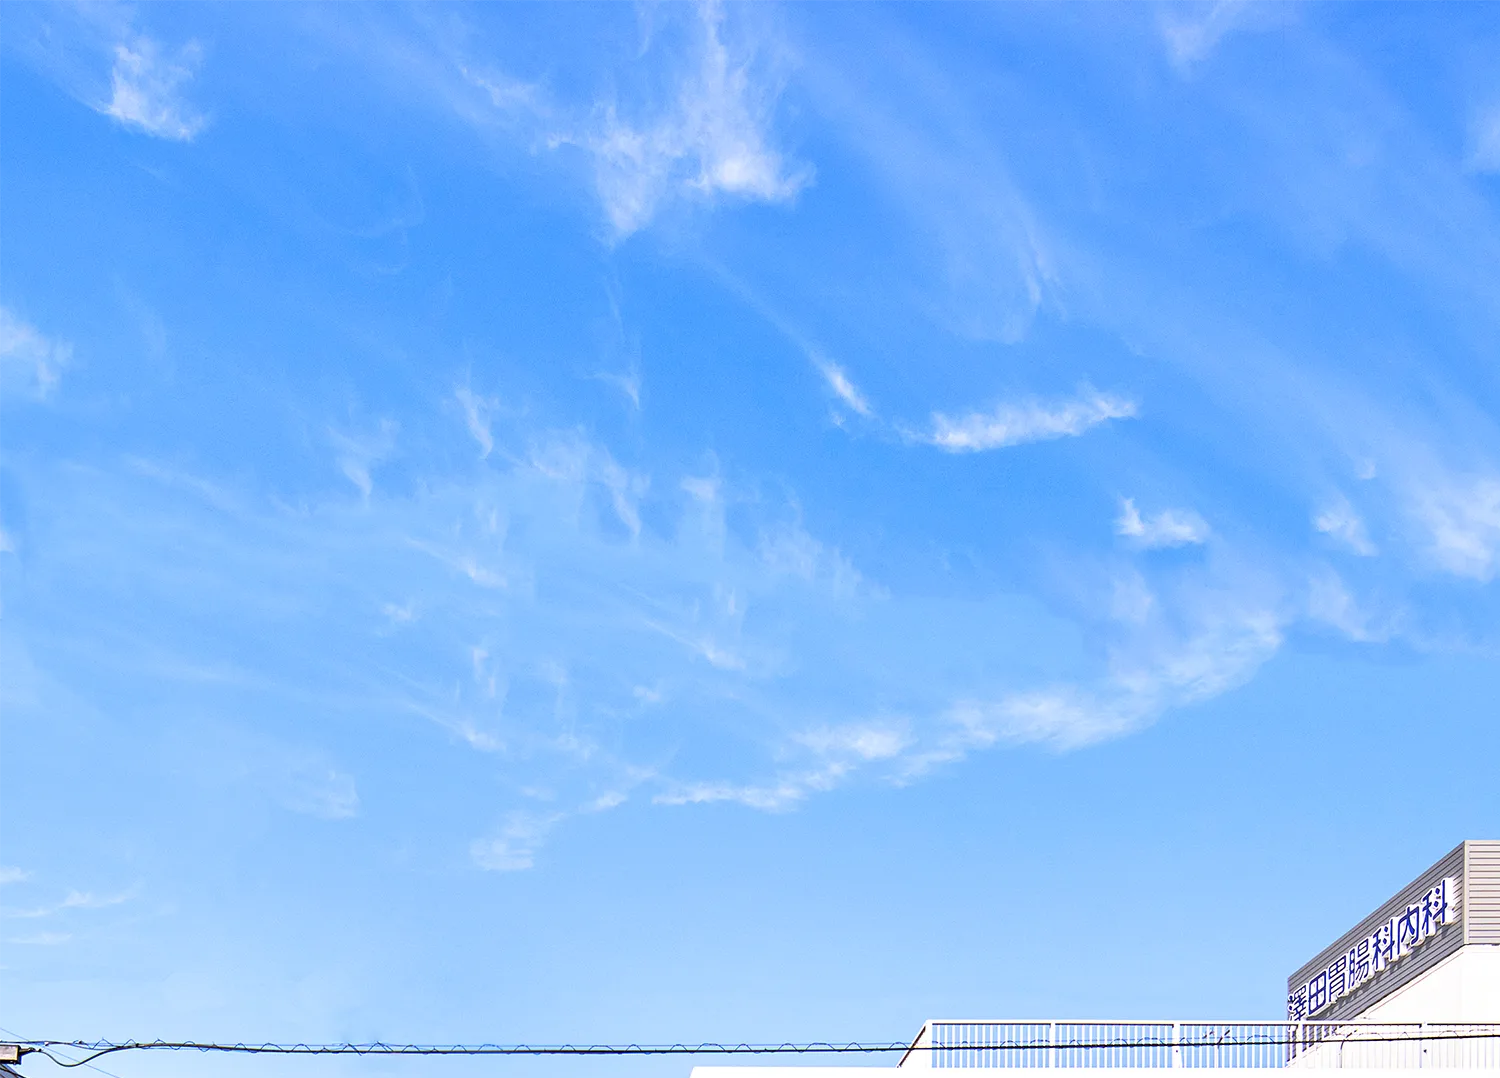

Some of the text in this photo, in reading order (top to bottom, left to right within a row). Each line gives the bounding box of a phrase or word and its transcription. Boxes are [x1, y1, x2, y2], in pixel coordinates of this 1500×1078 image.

[1288, 878, 1452, 1021] 澤田胃腸科内科
